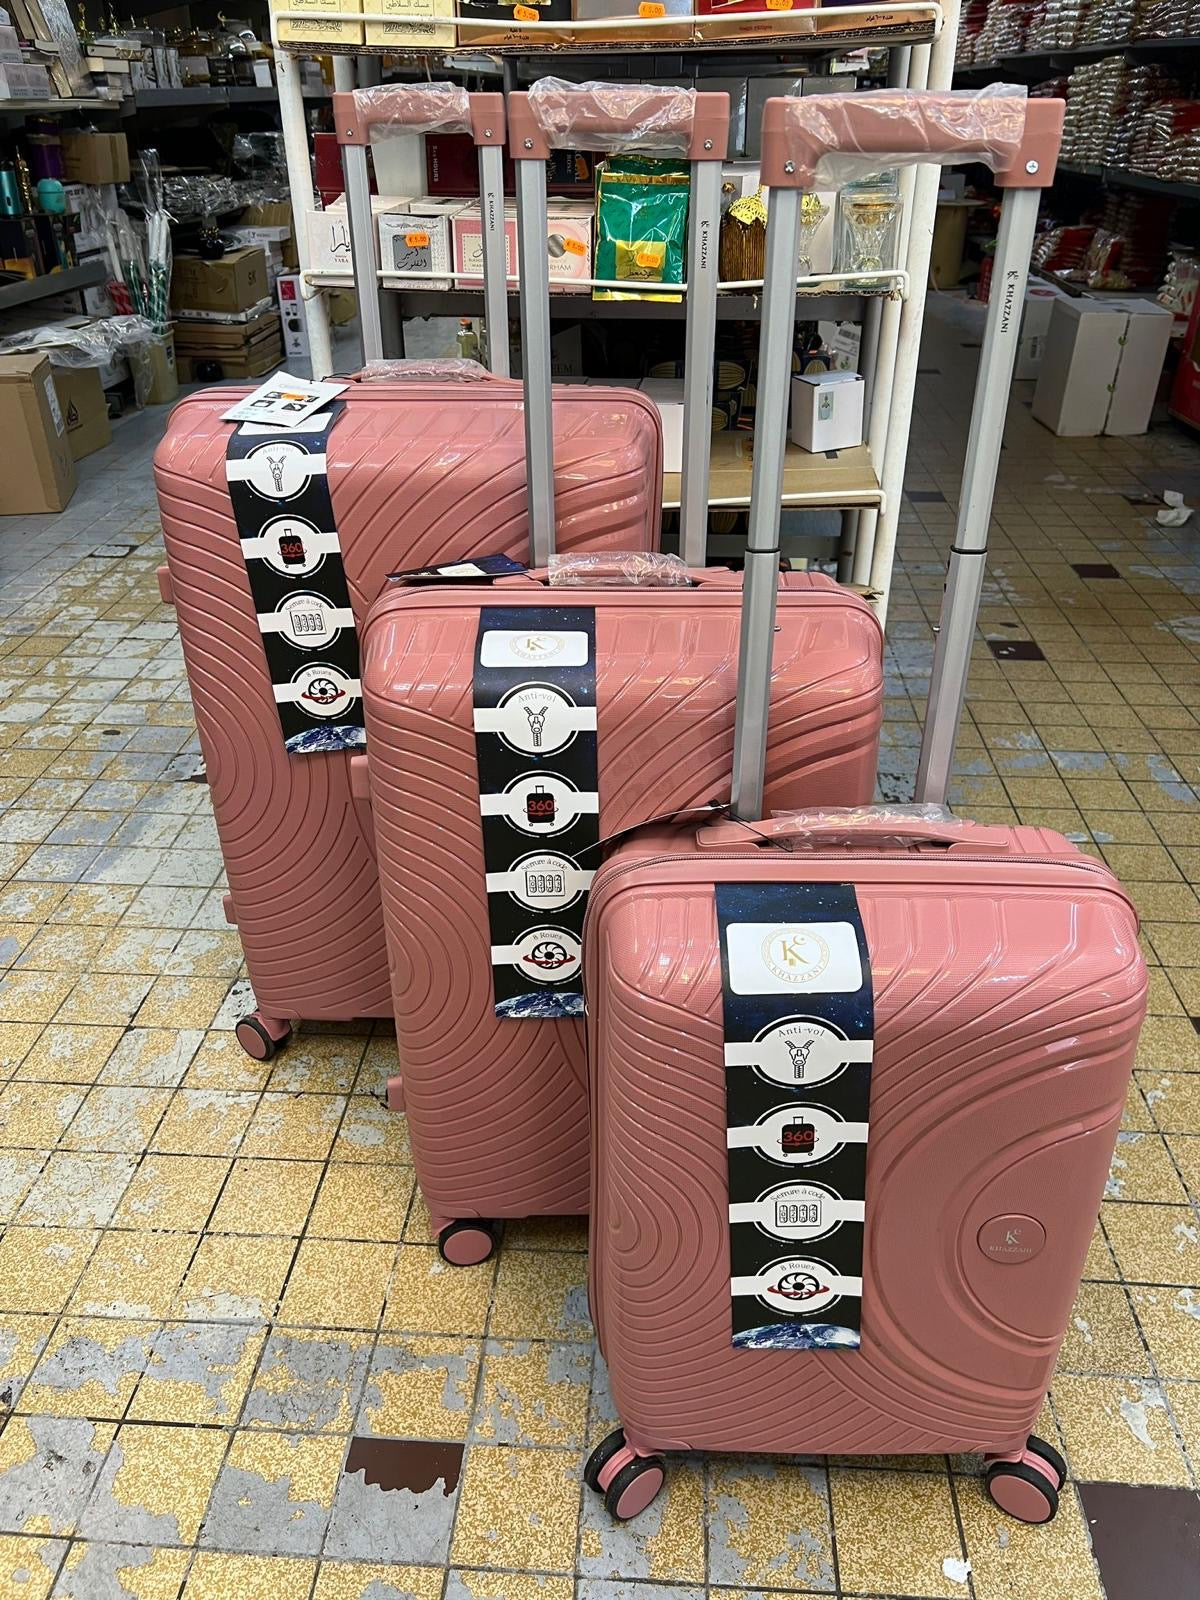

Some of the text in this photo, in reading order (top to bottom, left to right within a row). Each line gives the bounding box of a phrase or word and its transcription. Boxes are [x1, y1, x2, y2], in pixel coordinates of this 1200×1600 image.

[1001, 284, 1015, 333] KHAZZANI
[281, 543, 302, 554] 360
[518, 692, 557, 703] Anti-vol
[528, 800, 554, 811] 360
[540, 932, 563, 940] Roues
[778, 1026, 825, 1038] Anti-vol
[783, 1130, 814, 1142] 360
[770, 1189, 799, 1201] Serrure
[807, 1190, 826, 1200] code
[788, 1262, 816, 1271] Roues
